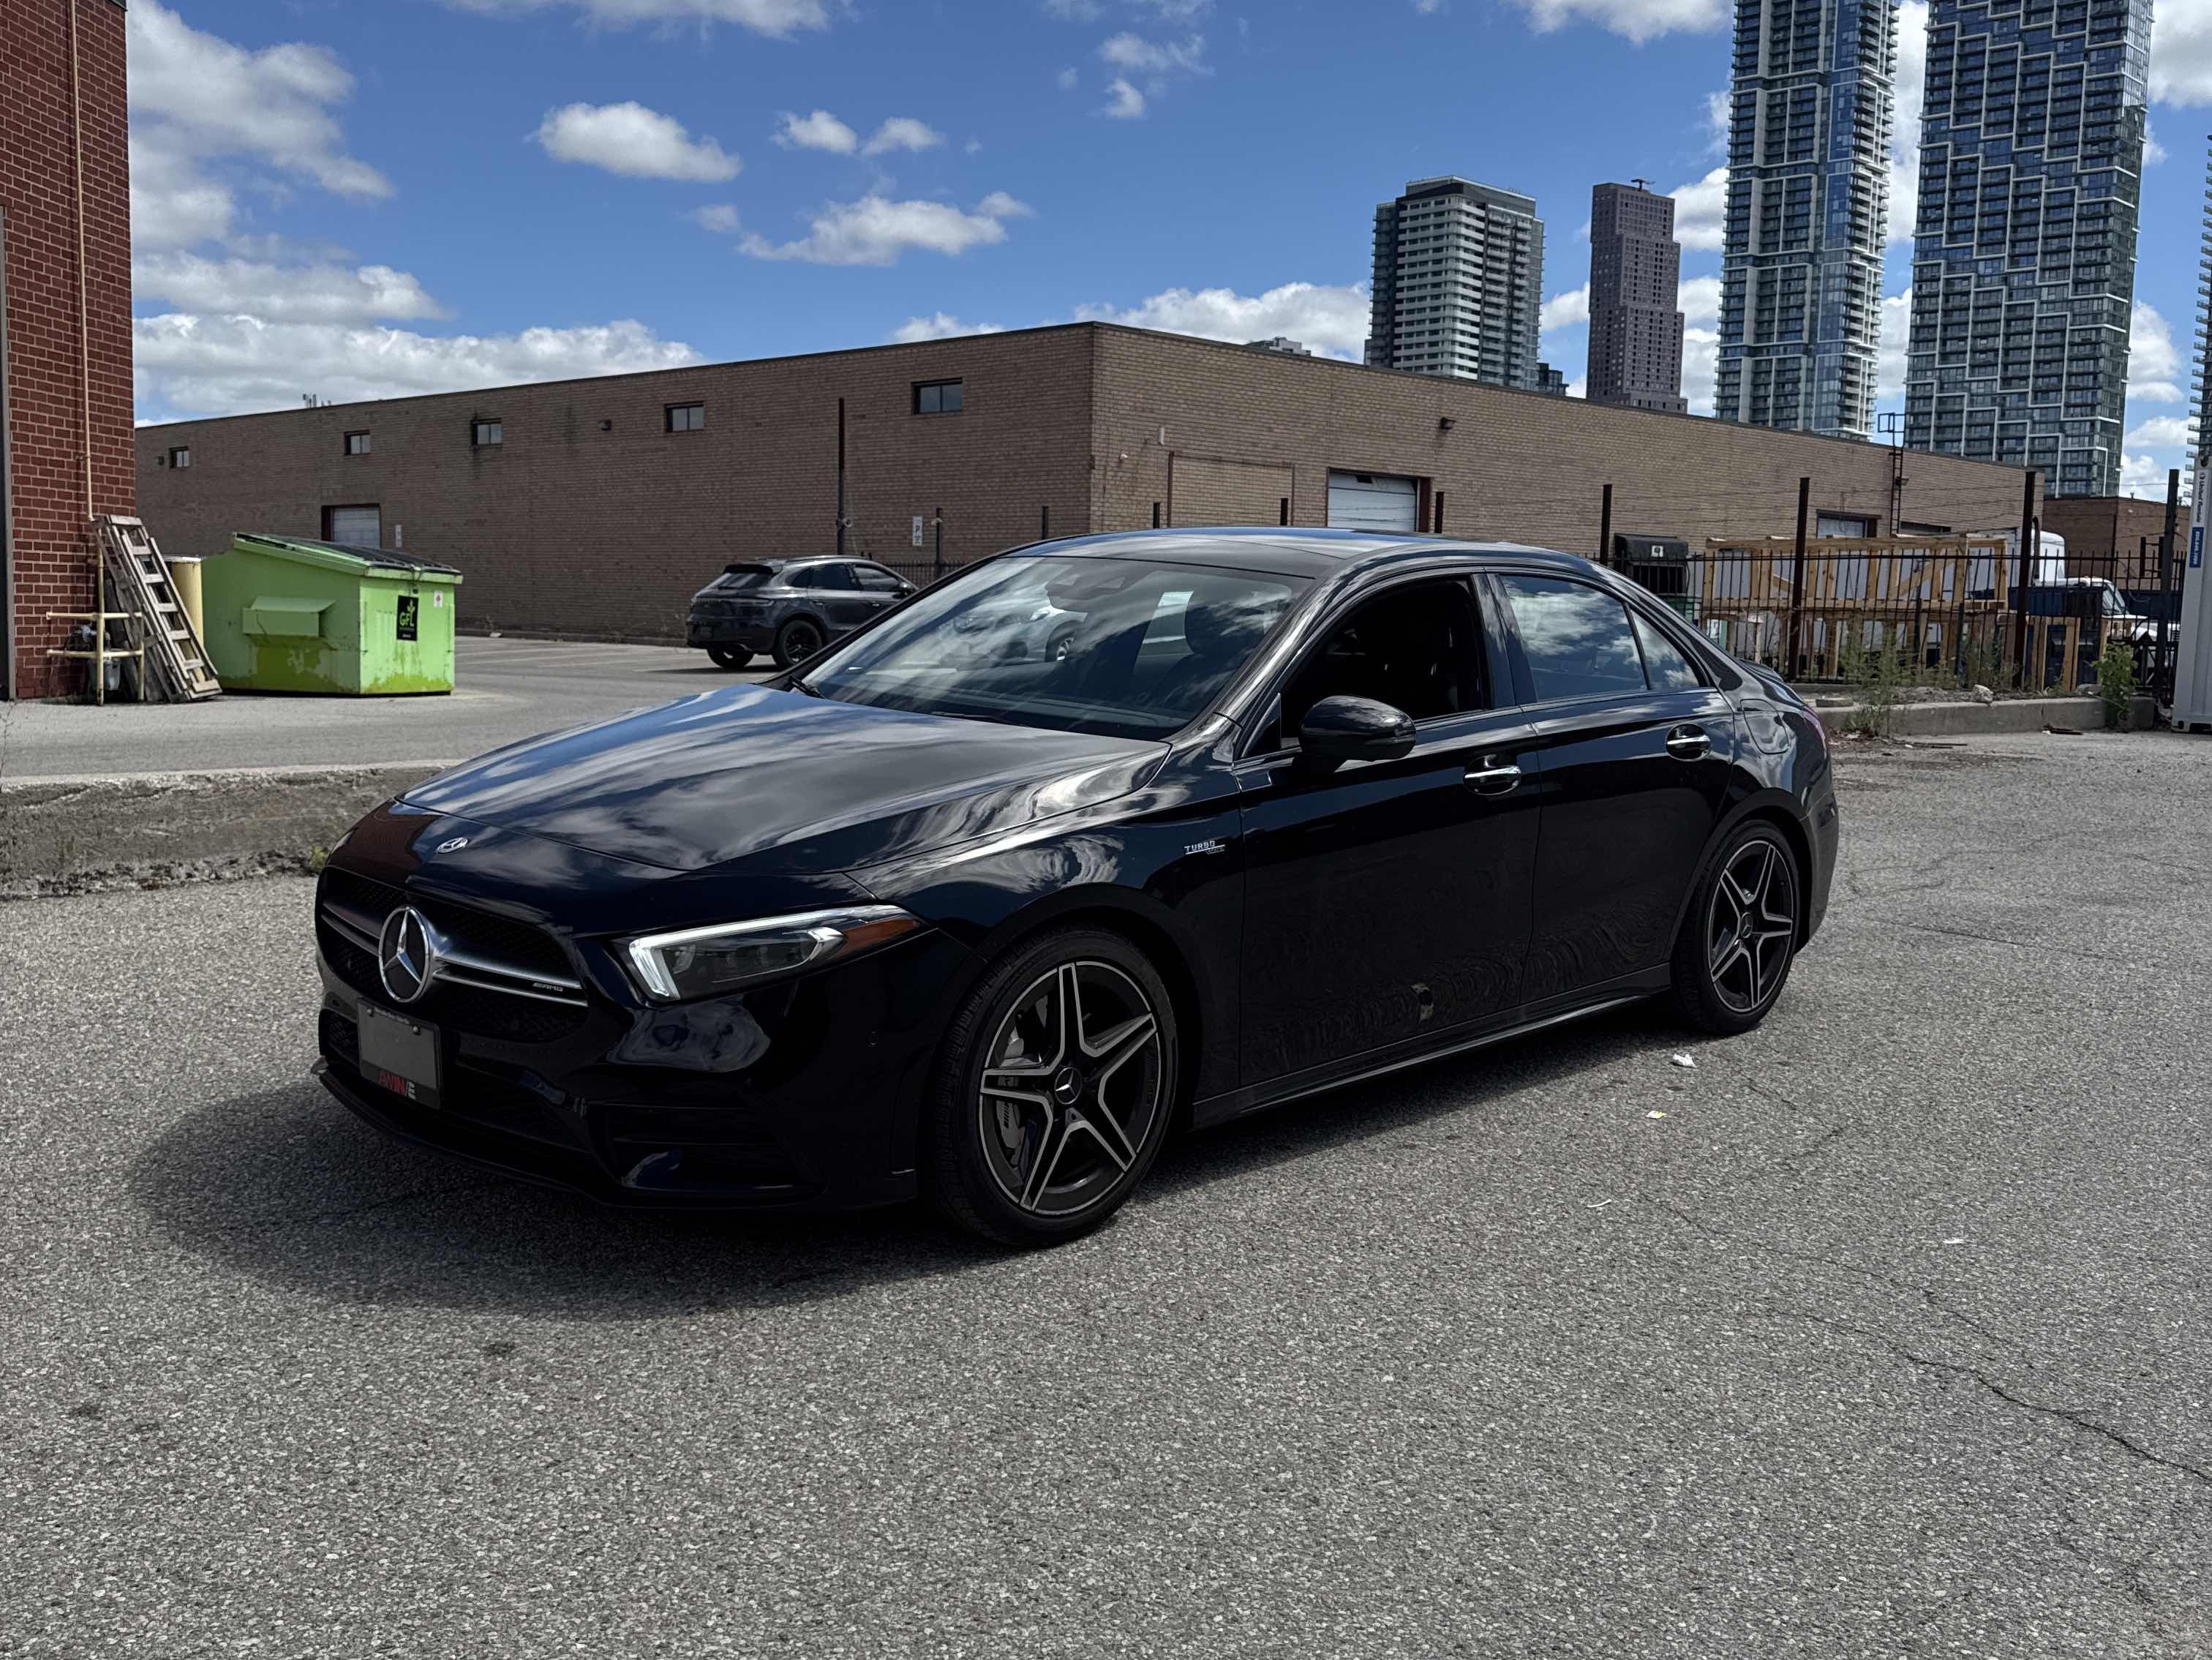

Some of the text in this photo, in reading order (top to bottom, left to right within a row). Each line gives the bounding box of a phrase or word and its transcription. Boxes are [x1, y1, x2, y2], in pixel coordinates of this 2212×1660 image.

[915, 525, 920, 533] P
[399, 612, 415, 627] GFL
[1184, 841, 1216, 852] TURBO
